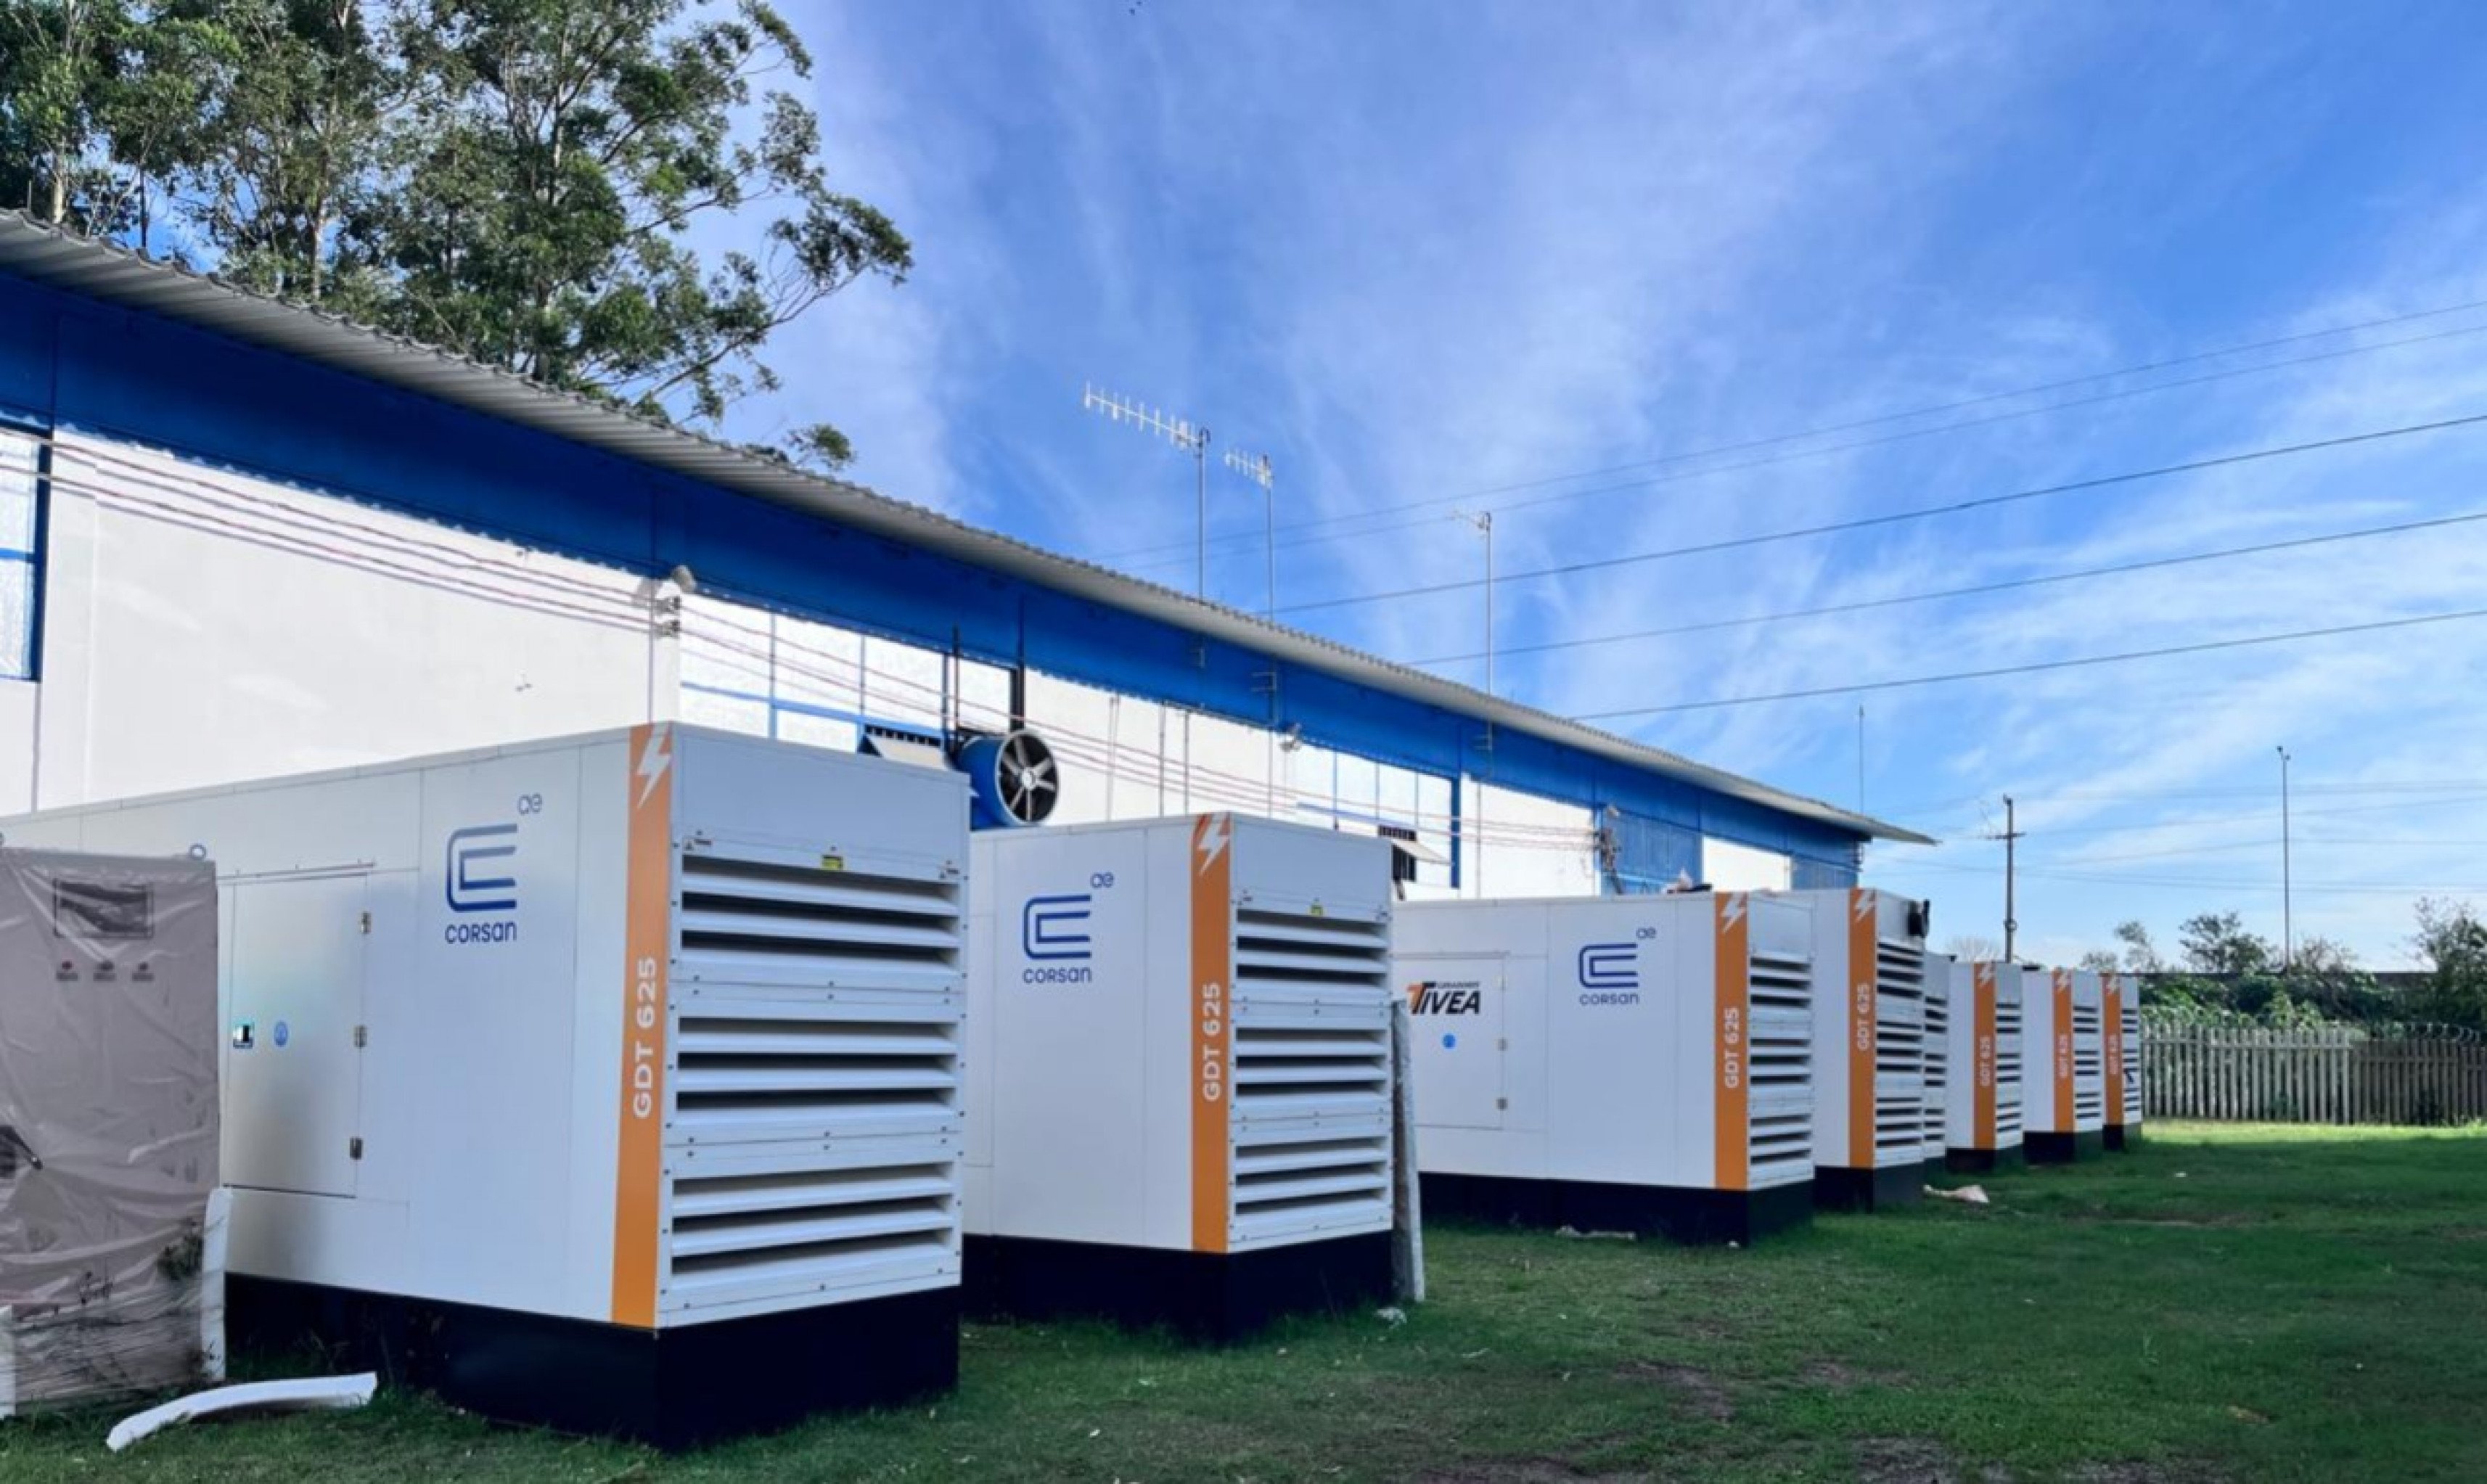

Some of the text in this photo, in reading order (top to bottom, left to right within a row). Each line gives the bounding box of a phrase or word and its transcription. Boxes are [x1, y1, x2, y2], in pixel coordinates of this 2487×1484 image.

[632, 956, 656, 1118] GDT 625
[1202, 982, 1222, 1102] GDT 625
[1724, 1006, 1740, 1089] GDT 625
